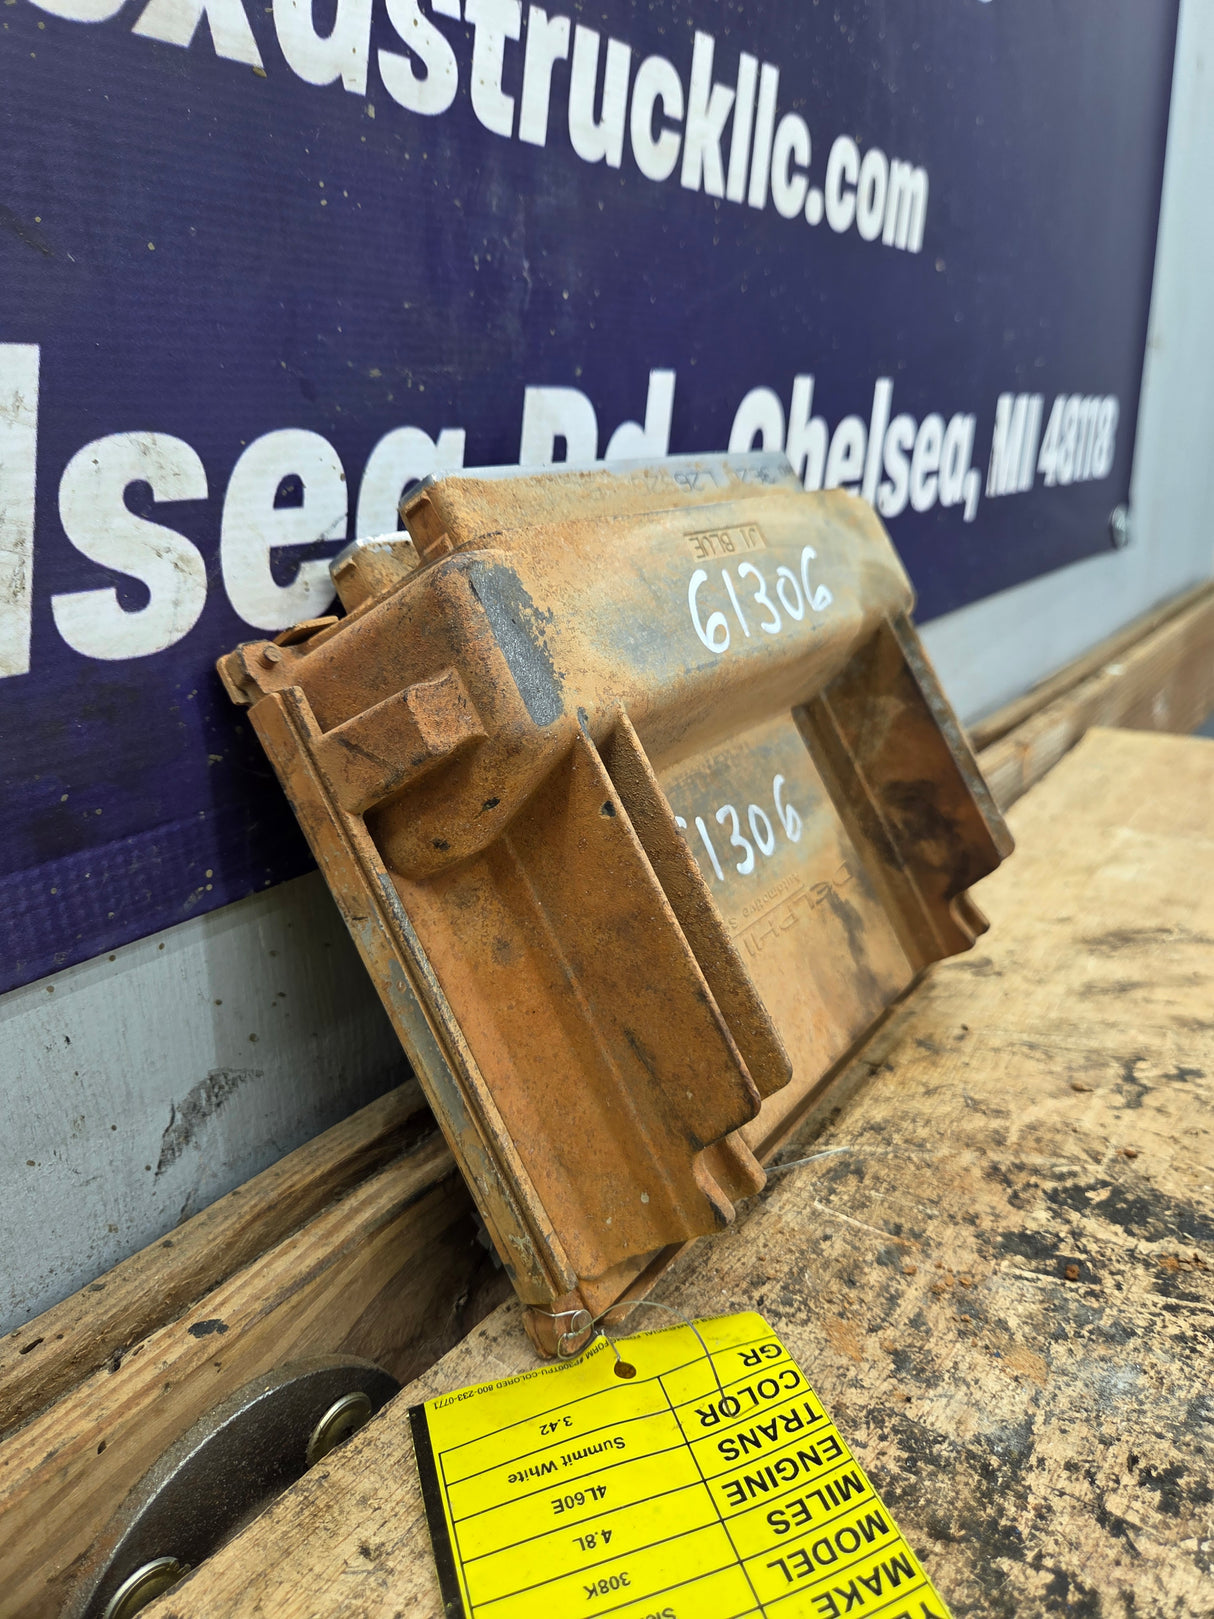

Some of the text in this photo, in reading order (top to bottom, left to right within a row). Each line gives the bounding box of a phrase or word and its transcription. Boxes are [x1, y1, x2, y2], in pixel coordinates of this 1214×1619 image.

[25, 0, 928, 253] astruckllc.com
[986, 392, 1045, 498] MI
[1037, 393, 1120, 488] 48118
[688, 532, 735, 559] BLUE
[688, 545, 834, 653] 61306
[675, 774, 803, 881] 1306
[585, 1340, 609, 1360] FORM
[737, 1343, 782, 1367] GR
[433, 1384, 494, 1410] 800-233-0771
[539, 1415, 573, 1436] 3.42
[694, 1369, 800, 1427] COLOR
[507, 1436, 626, 1484] Summit White
[717, 1402, 823, 1461] TRANS
[721, 1434, 843, 1507] ENGINE
[551, 1485, 607, 1515] 4L60E
[766, 1470, 866, 1535] MILES
[572, 1529, 612, 1551] 4.8L
[767, 1509, 890, 1583] MODEL
[583, 1571, 631, 1600] 308K
[811, 1551, 916, 1619] MAKE
